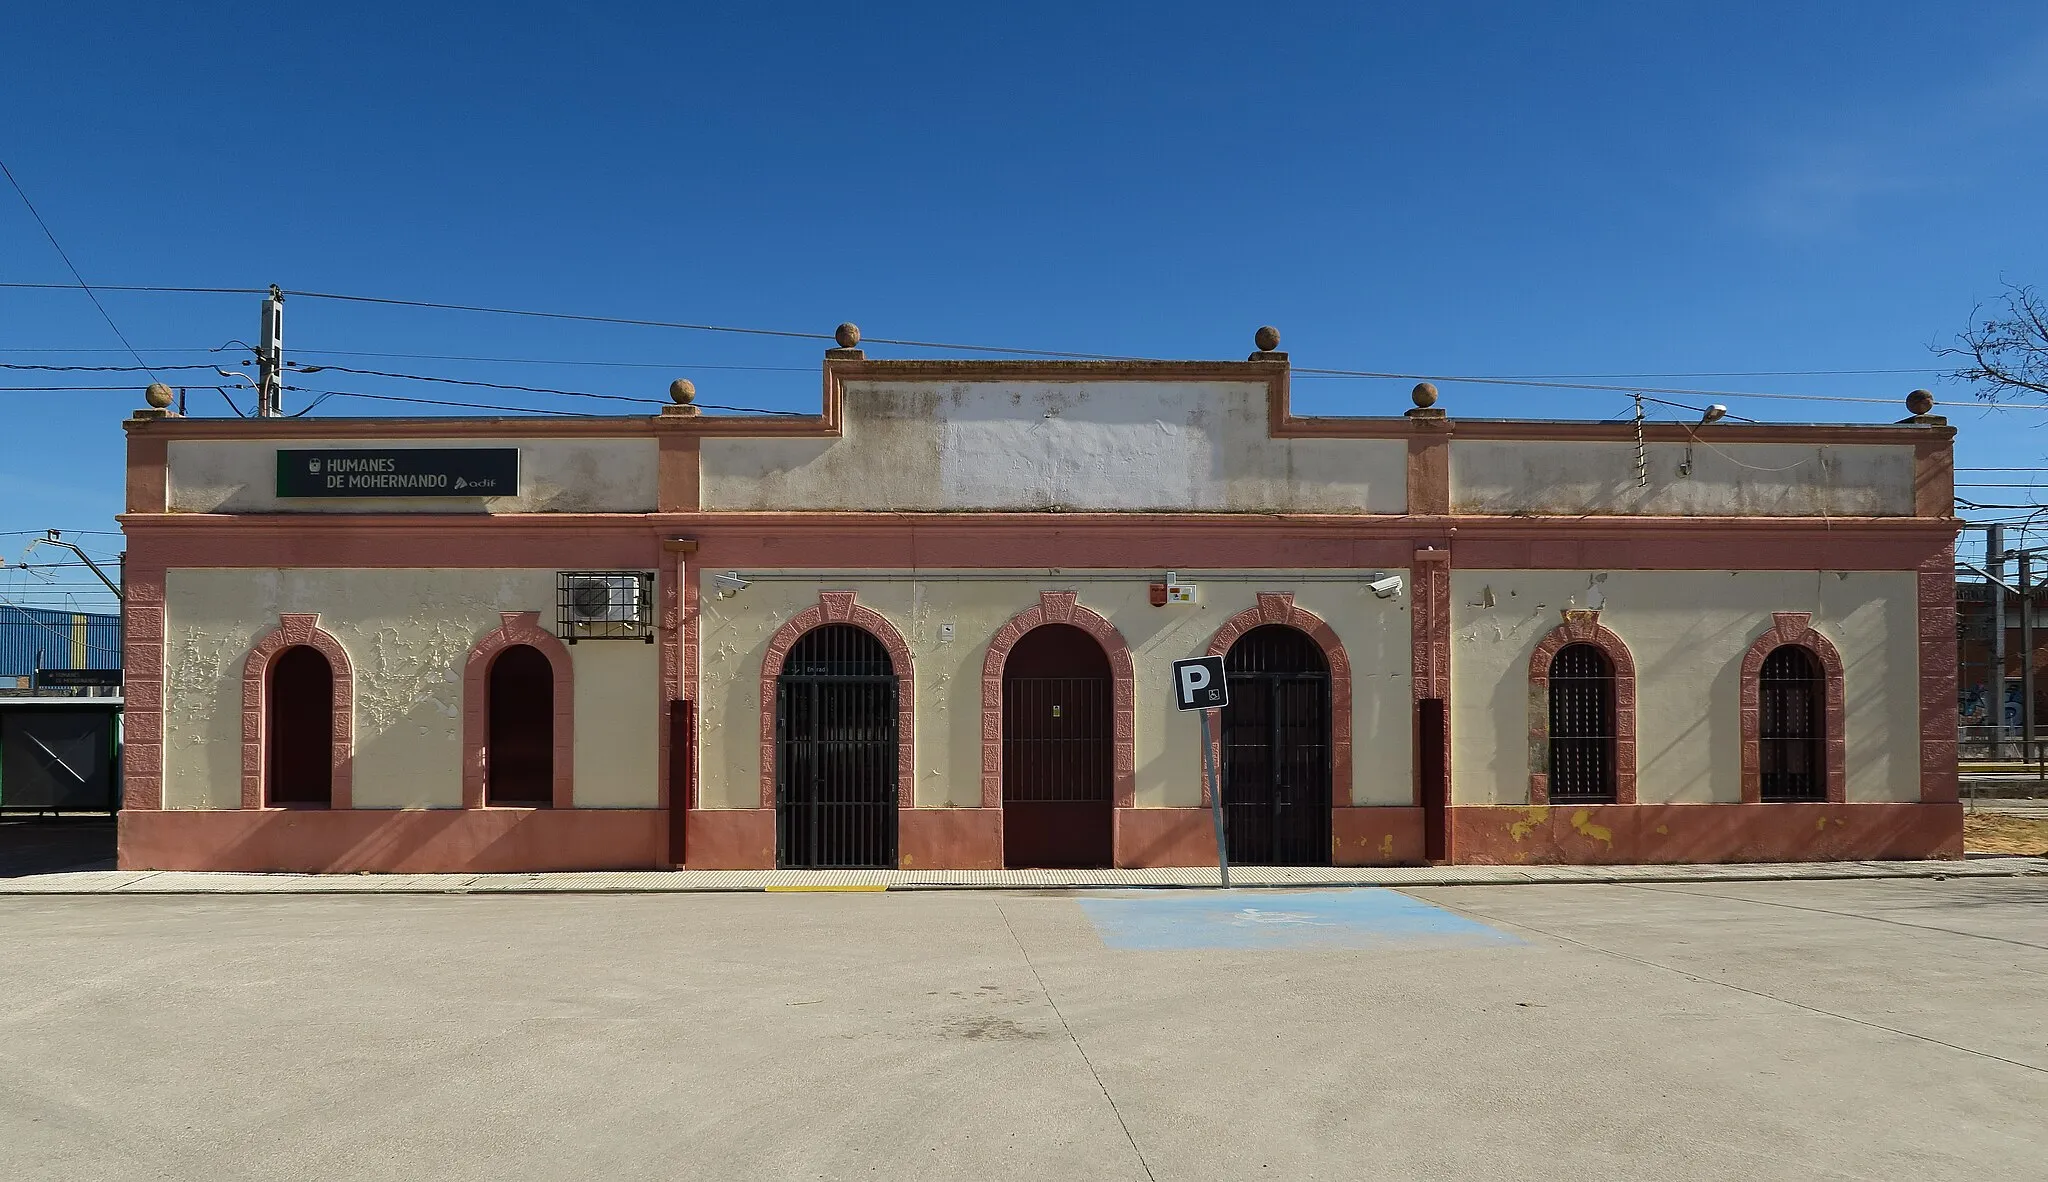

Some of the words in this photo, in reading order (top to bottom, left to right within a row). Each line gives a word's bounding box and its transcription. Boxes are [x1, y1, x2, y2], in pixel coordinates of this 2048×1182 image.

[327, 458, 395, 472] HUMANES
[327, 474, 345, 488] DE
[348, 474, 448, 488] MOHERNANDO
[468, 479, 497, 487] adif
[1180, 664, 1211, 704] P
